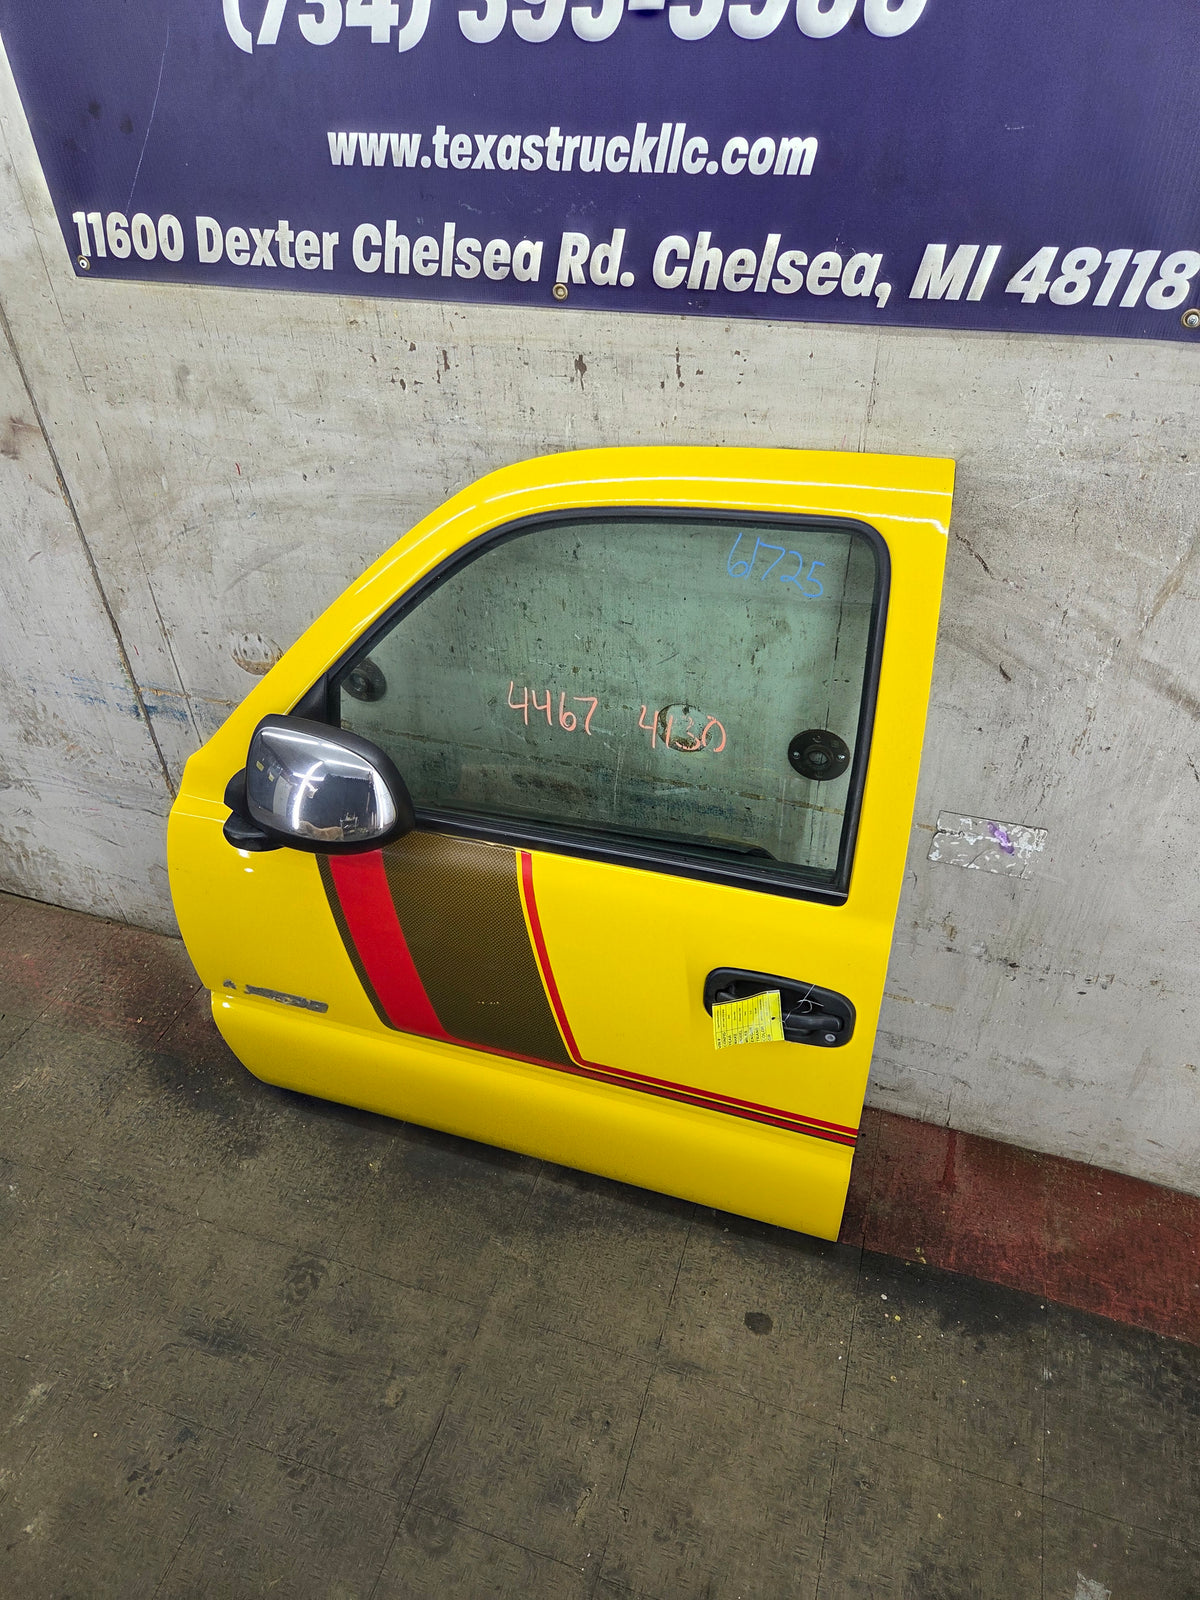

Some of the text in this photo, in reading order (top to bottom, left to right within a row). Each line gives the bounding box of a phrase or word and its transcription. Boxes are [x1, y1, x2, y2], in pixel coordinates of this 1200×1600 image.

[327, 122, 819, 177] www.texastruckllc.com
[72, 211, 1200, 311] 11600 Dexter Chelsea Rd. Chelsea, MI 48118
[507, 680, 727, 753] 4467 4130
